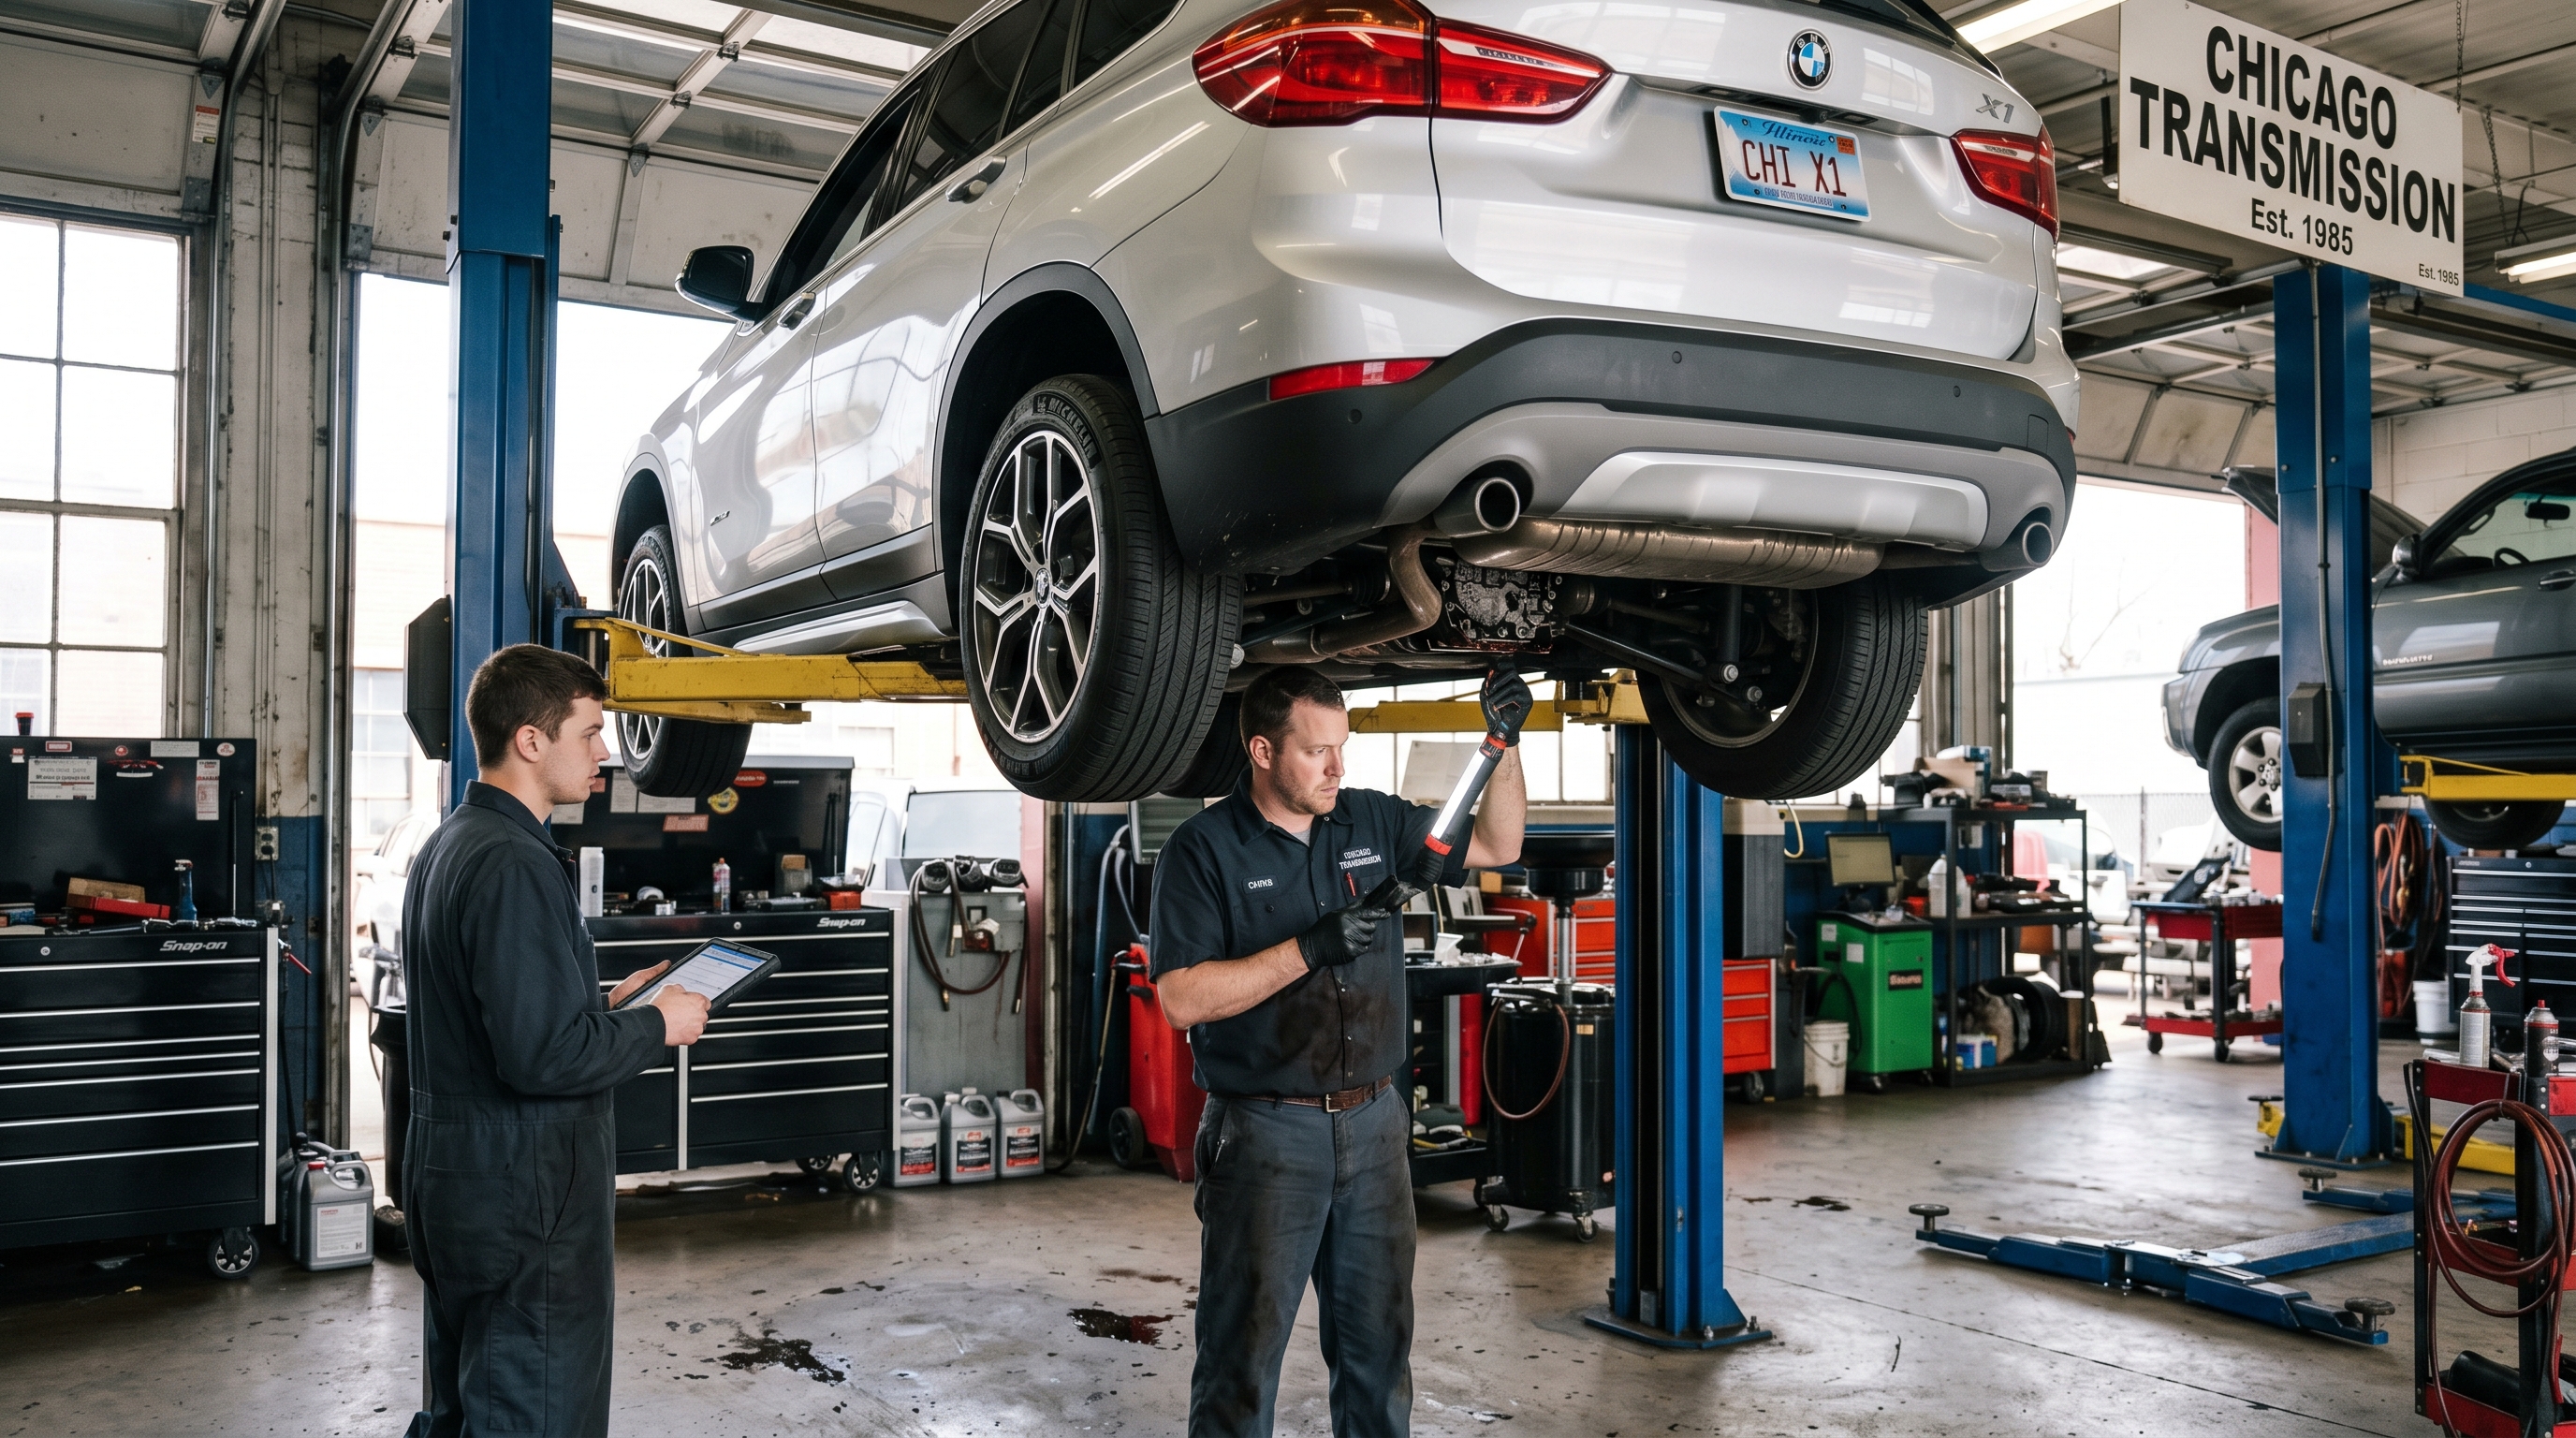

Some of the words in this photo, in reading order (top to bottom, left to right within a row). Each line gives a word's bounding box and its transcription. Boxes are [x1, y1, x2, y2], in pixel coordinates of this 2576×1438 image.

[1975, 93, 2014, 124] X1
[2206, 25, 2397, 150] CHICAGO
[1742, 139, 1796, 188] CHI
[1809, 151, 1847, 198] X1
[2130, 76, 2455, 243] TRANSMISSION
[2250, 198, 2293, 239] Est.
[2302, 214, 2353, 256] 1985
[2419, 263, 2436, 280] Est.
[2437, 269, 2459, 286] 1985
[816, 917, 866, 929] Snap-on
[159, 940, 227, 953] Snap-on
